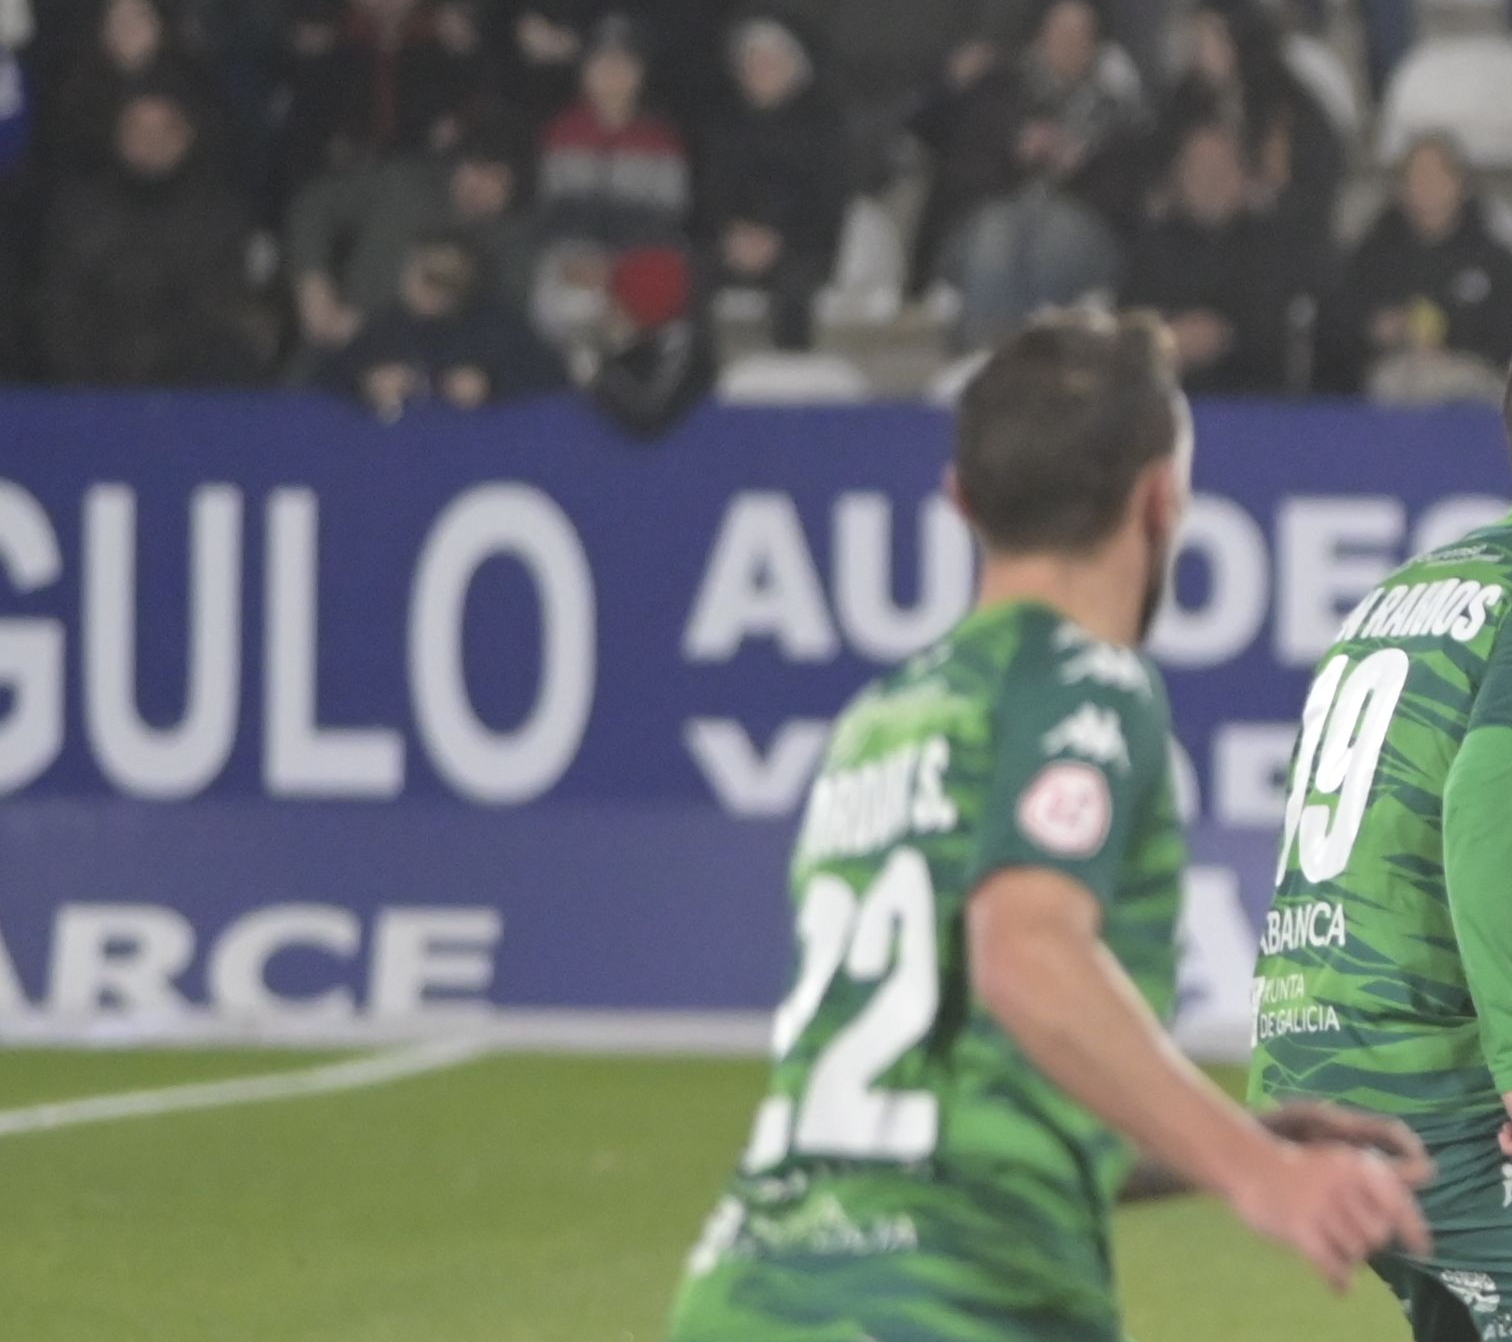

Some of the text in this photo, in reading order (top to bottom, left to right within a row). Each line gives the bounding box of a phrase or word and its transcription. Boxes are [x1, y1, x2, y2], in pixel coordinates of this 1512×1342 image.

[1359, 577, 1503, 643] RAMOS
[1275, 647, 1409, 888] 19
[0, 901, 504, 1017] RCE
[1276, 1005, 1341, 1036] GALICIA
